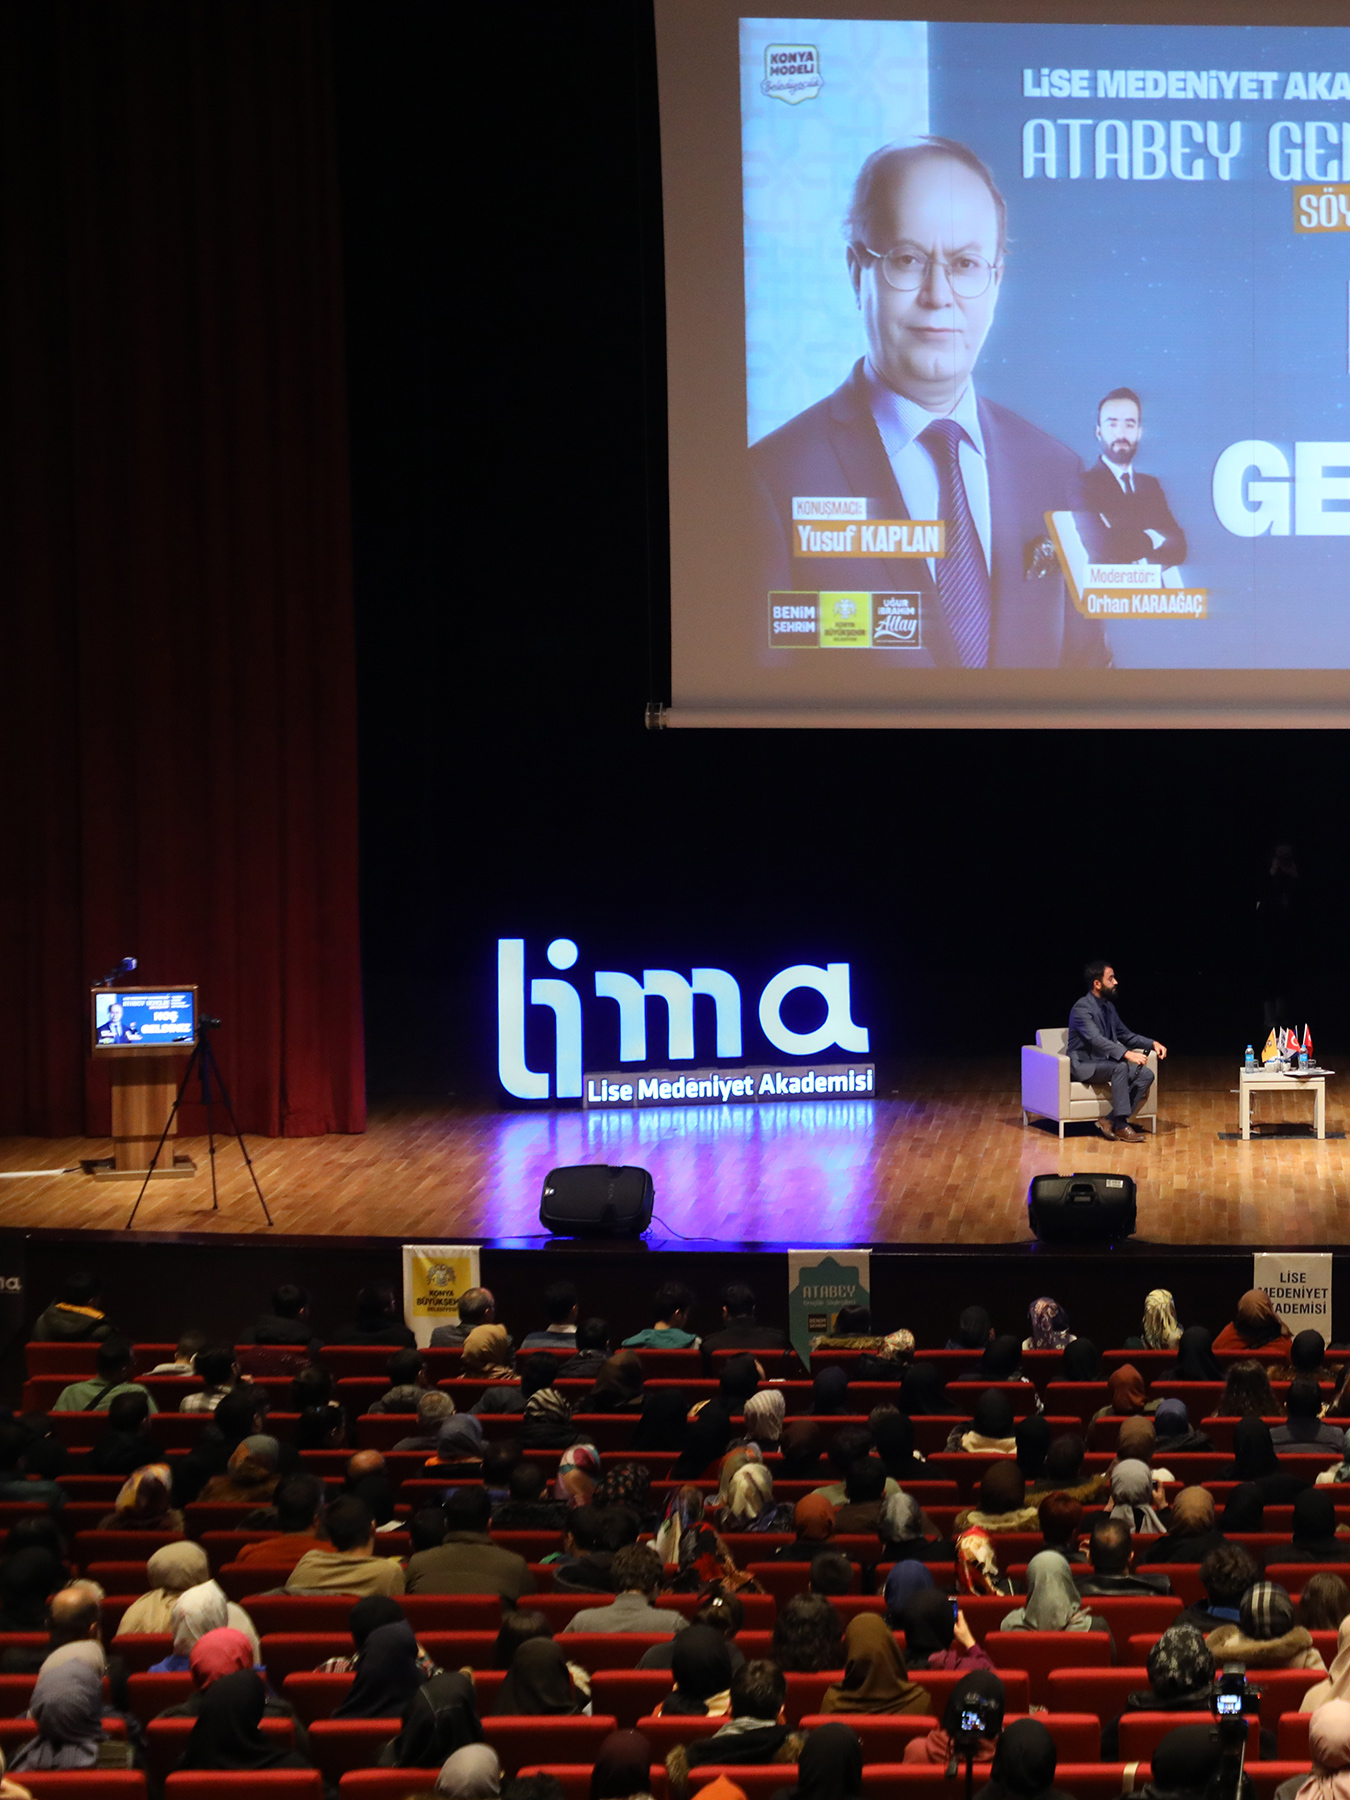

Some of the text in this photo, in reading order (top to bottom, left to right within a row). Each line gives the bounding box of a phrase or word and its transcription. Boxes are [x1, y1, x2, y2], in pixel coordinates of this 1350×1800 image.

[771, 51, 814, 64] KONYA
[1022, 118, 1240, 181] ATABEY
[796, 501, 862, 518] KONUŞMACI:
[797, 525, 940, 552] Yusuf KAPLAN
[1090, 567, 1155, 583] Moderatör:
[1087, 591, 1203, 618] Orhan KARAAĞAÇ
[498, 938, 870, 1100] lima
[588, 1069, 874, 1102] Lise Medeniyet Akademisi
[802, 1285, 856, 1298] ATABEY
[1270, 1302, 1327, 1315] ADEMİSİ
